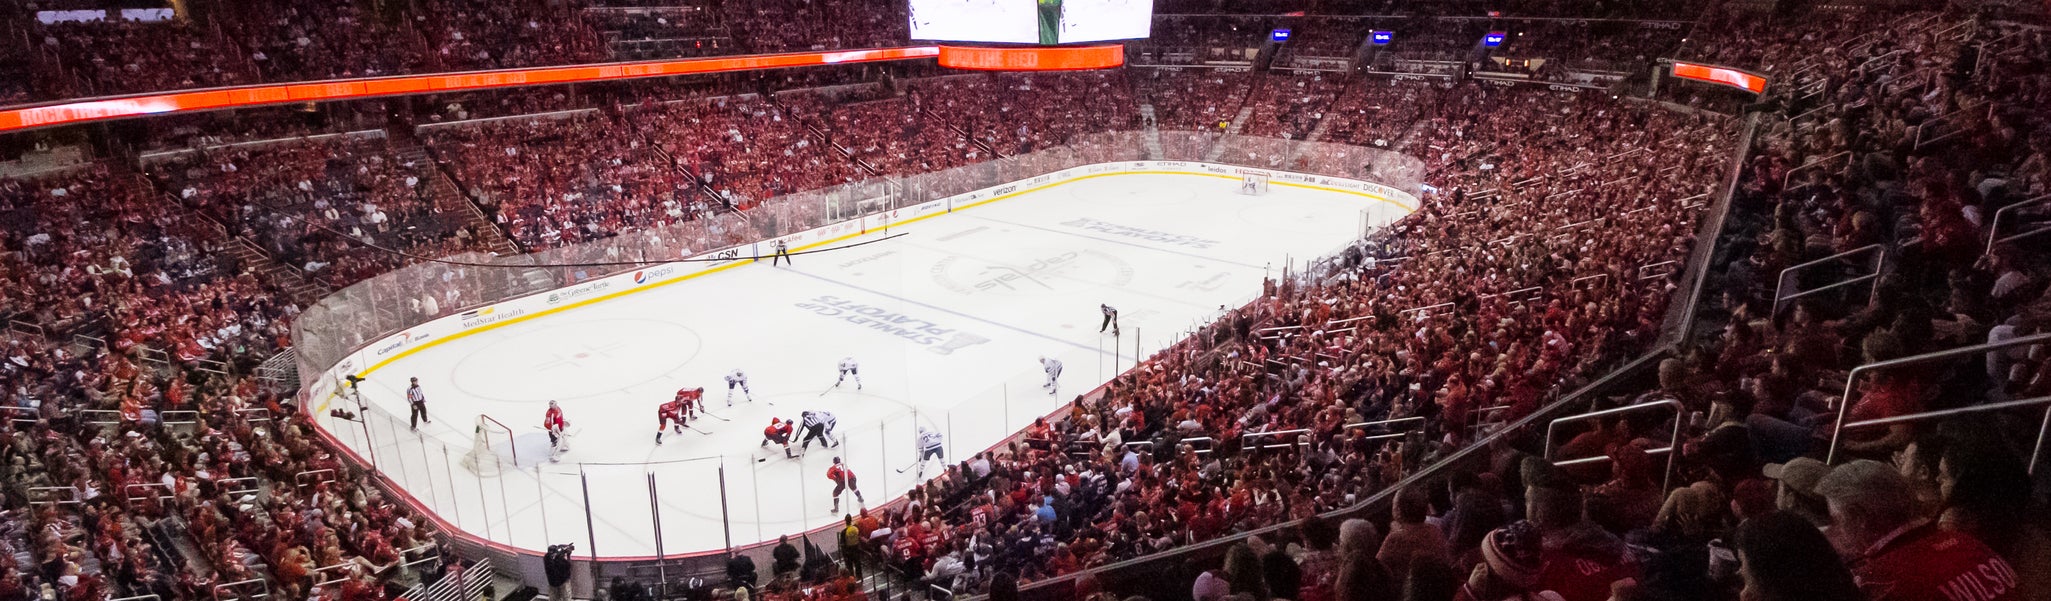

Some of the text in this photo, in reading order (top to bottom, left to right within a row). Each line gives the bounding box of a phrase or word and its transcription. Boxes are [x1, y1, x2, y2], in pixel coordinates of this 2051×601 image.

[19, 106, 68, 126] ROCK
[1208, 165, 1227, 174] leidos
[993, 184, 1017, 197] verizon
[717, 248, 739, 261] CSN
[647, 266, 674, 280] pepsi
[463, 308, 525, 329] MedStar Health
[794, 302, 944, 346] STANLEY CUP
[811, 295, 956, 336] PLAYOFFS
[1938, 555, 2018, 601] WILSO
